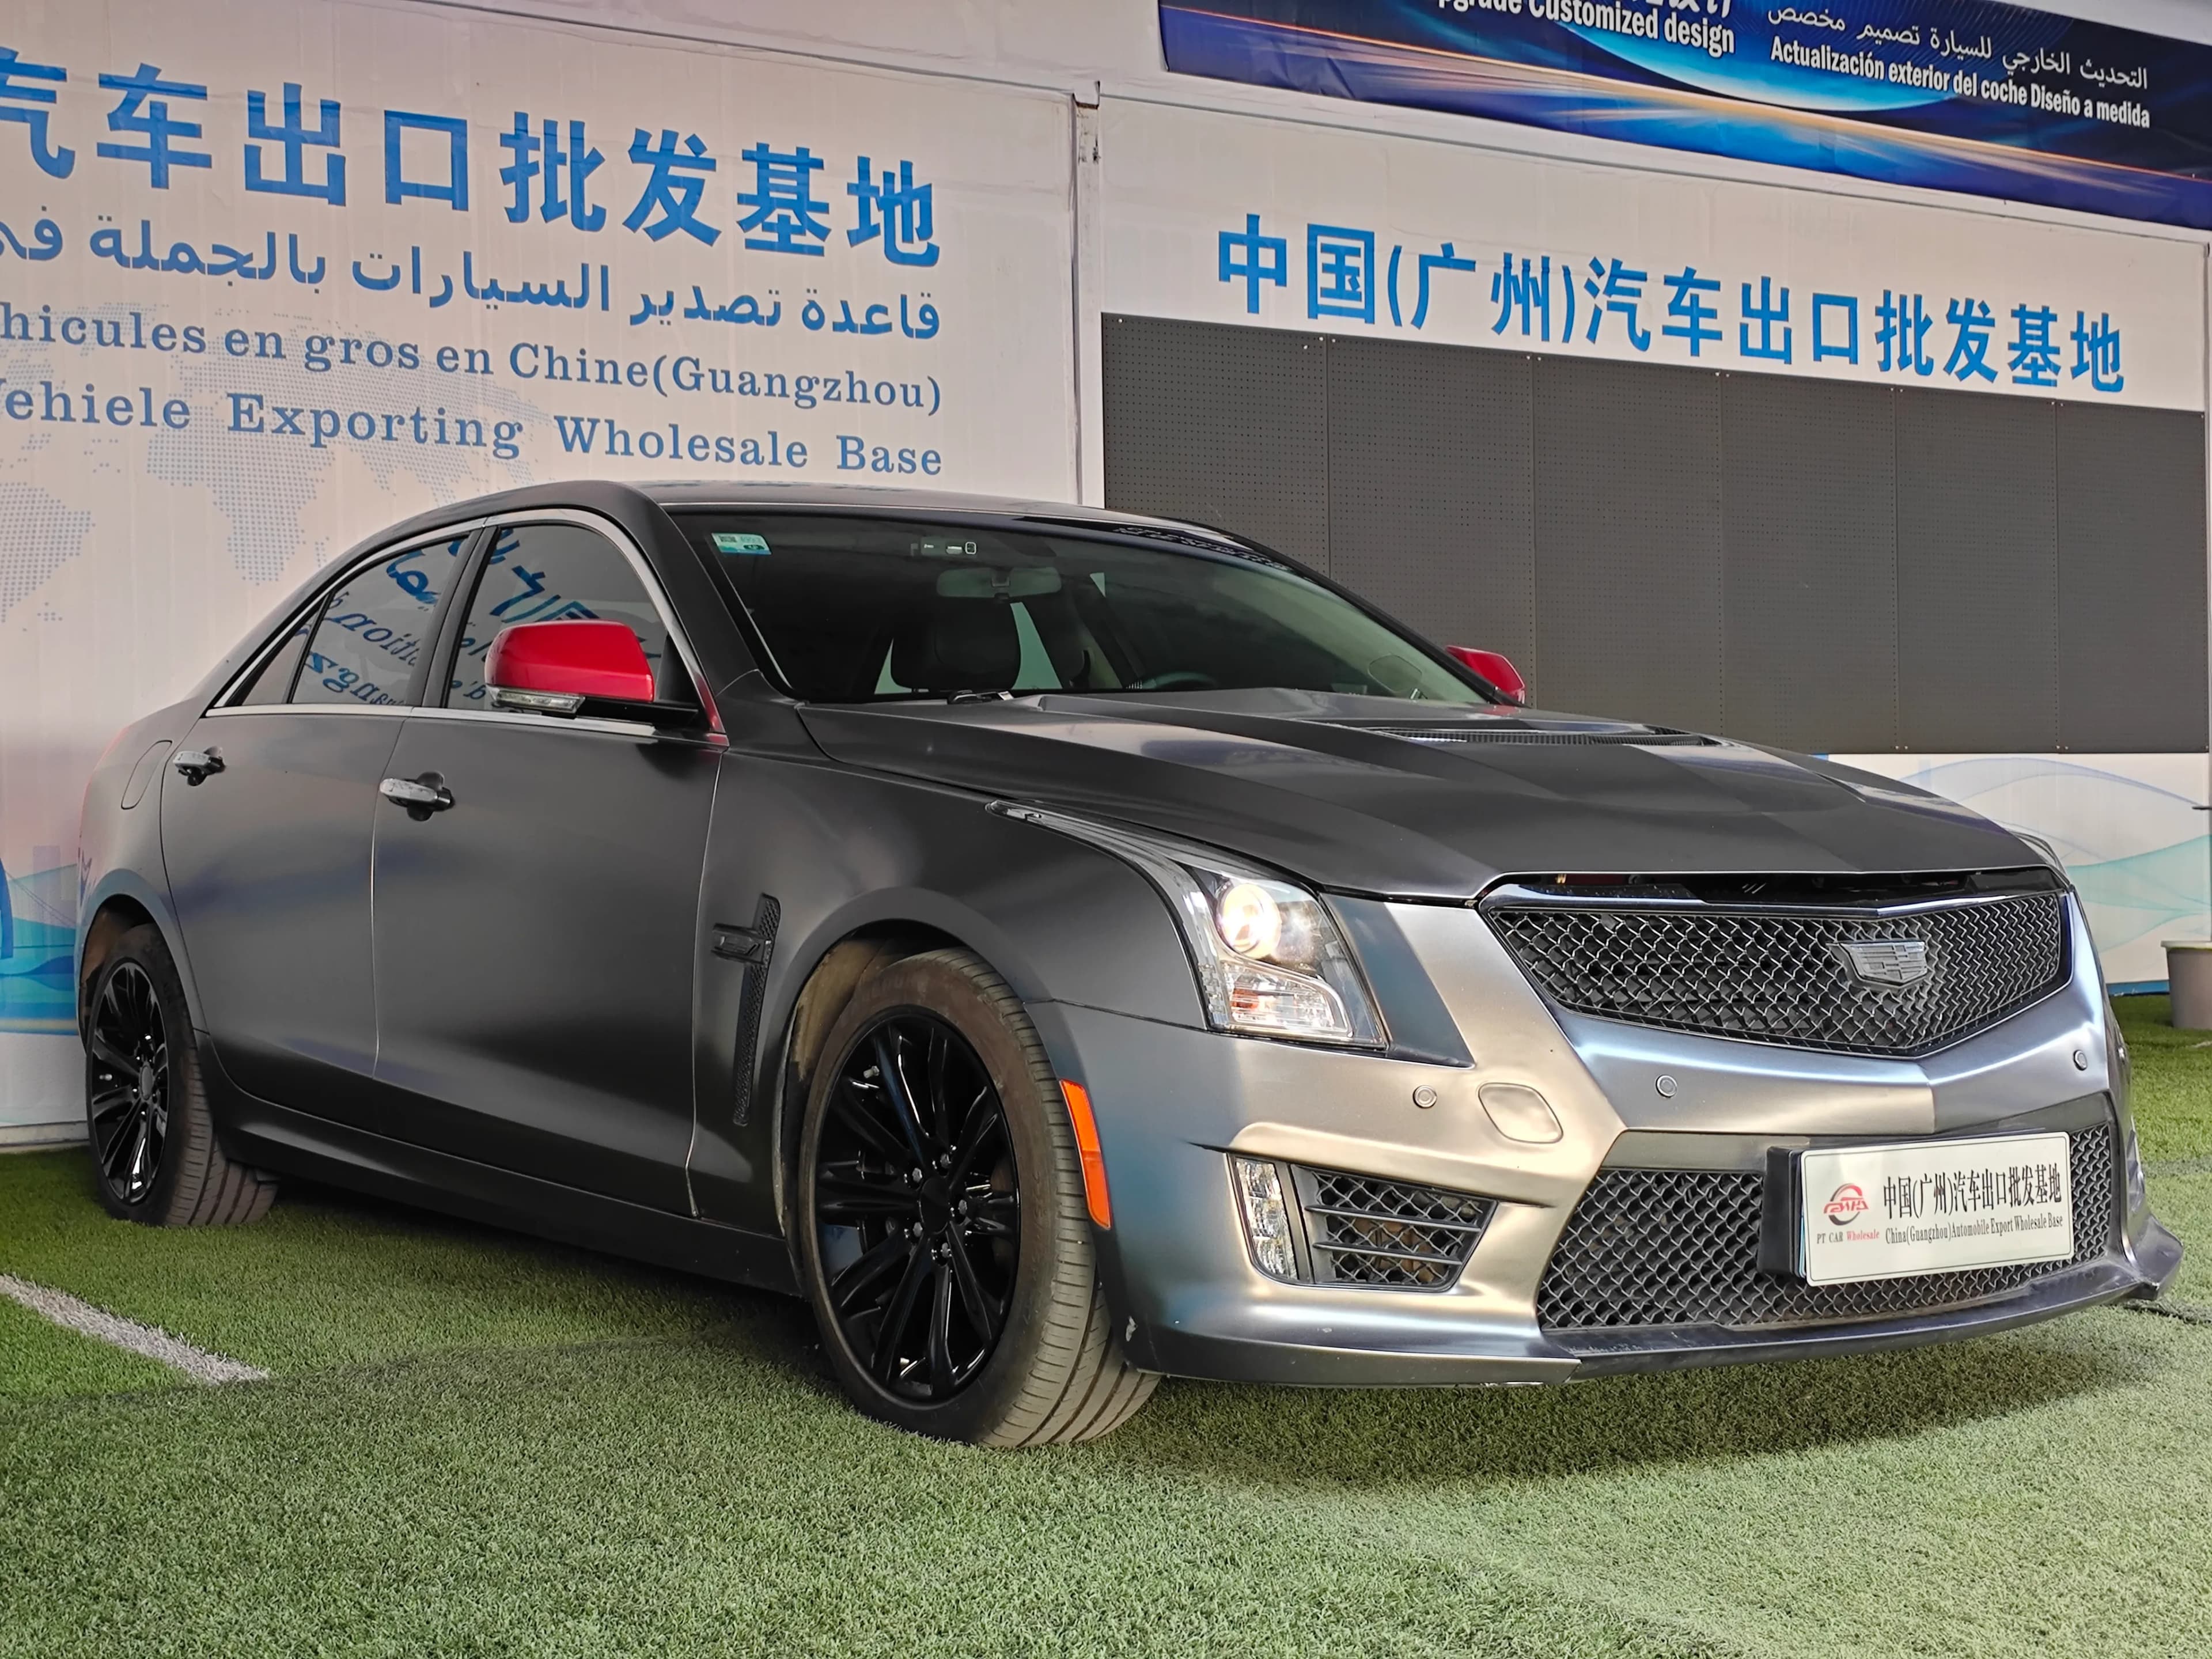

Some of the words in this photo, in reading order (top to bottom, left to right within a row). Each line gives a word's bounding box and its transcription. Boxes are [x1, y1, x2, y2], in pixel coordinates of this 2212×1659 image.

[1438, 0, 1522, 14] gade
[1529, 0, 1658, 39] Customized
[1664, 12, 1735, 58] design
[1767, 6, 1846, 32] مخصص
[1856, 24, 1921, 46] تصميم
[1930, 27, 1992, 61] للسيارة
[1770, 35, 1885, 81] Actualización
[1888, 60, 1950, 93] exterior
[1953, 69, 1978, 97] del
[1980, 79, 2028, 106] coche
[2030, 82, 2081, 116] Diseño
[2084, 99, 2093, 119] a
[2096, 99, 2151, 128] medida
[2002, 47, 2071, 77] الخارجي
[2080, 59, 2148, 89] التحديث
[89, 215, 325, 294] بالجملة
[352, 247, 609, 311] السيارات
[630, 285, 781, 326] تصدير
[802, 288, 941, 340] قاعدة
[1218, 213, 2125, 393] 中国(广州)汽车出口批发基地
[225, 328, 287, 359] en
[304, 336, 419, 372] gros
[437, 344, 494, 376] en
[509, 342, 942, 416] Chine(Guangzhou)
[0, 377, 191, 429] ehiele
[228, 392, 524, 459] Exporting
[554, 415, 809, 468] Wholesale
[836, 435, 942, 475] Base
[1884, 1162, 2062, 1219] 中国(广州)汽车出口批发基地
[1817, 1233, 1826, 1244] PT
[1829, 1231, 1843, 1243] CAR
[1846, 1229, 1880, 1241] Wholesale
[1885, 1217, 1990, 1245] China(Guangzhou)Automobile
[1990, 1218, 2013, 1236] Export
[2014, 1213, 2047, 1231] Wholesale
[2048, 1213, 2063, 1228] Base
